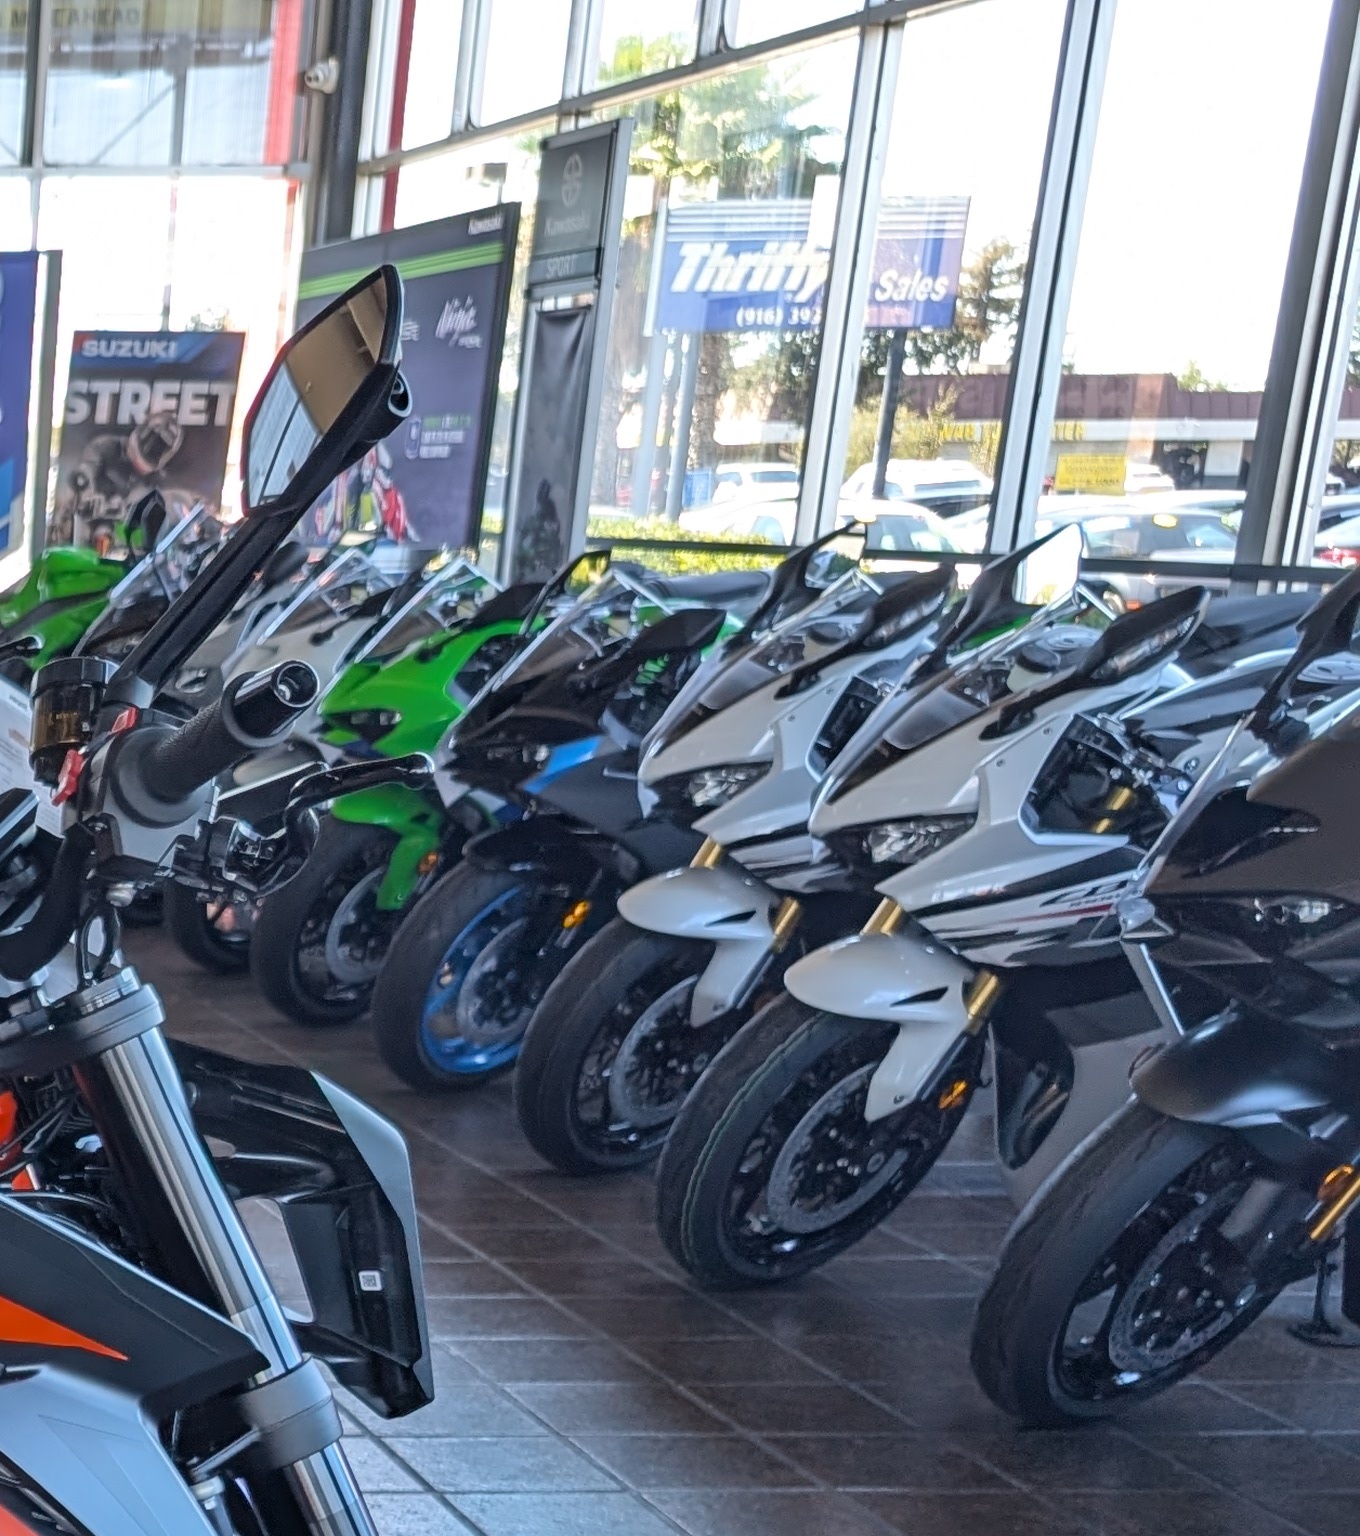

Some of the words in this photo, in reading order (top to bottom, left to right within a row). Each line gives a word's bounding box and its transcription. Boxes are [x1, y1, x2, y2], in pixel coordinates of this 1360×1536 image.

[545, 254, 579, 280] SPORT
[671, 240, 830, 304] Thrifty
[874, 267, 949, 303] Sales
[736, 306, 783, 328] (916)
[82, 340, 178, 359] SUZUKI
[65, 379, 236, 426] STREET
